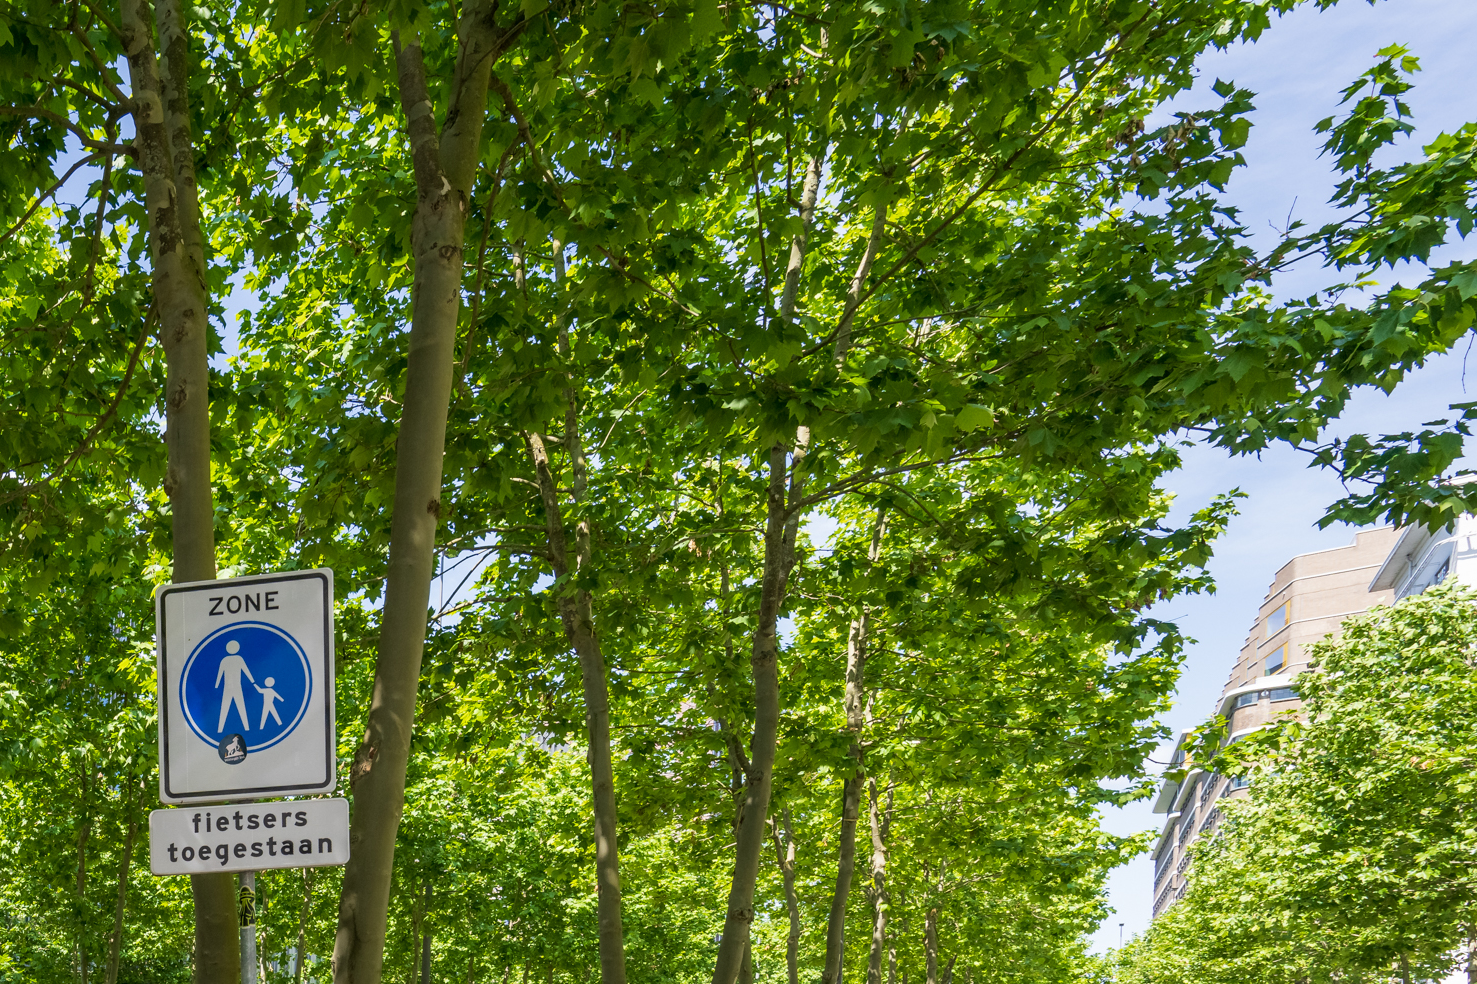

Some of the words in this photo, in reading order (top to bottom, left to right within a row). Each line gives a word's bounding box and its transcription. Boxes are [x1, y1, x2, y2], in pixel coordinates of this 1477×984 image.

[208, 591, 280, 616] ZONE
[192, 810, 308, 833] fietsers
[167, 836, 333, 866] toegestaan
